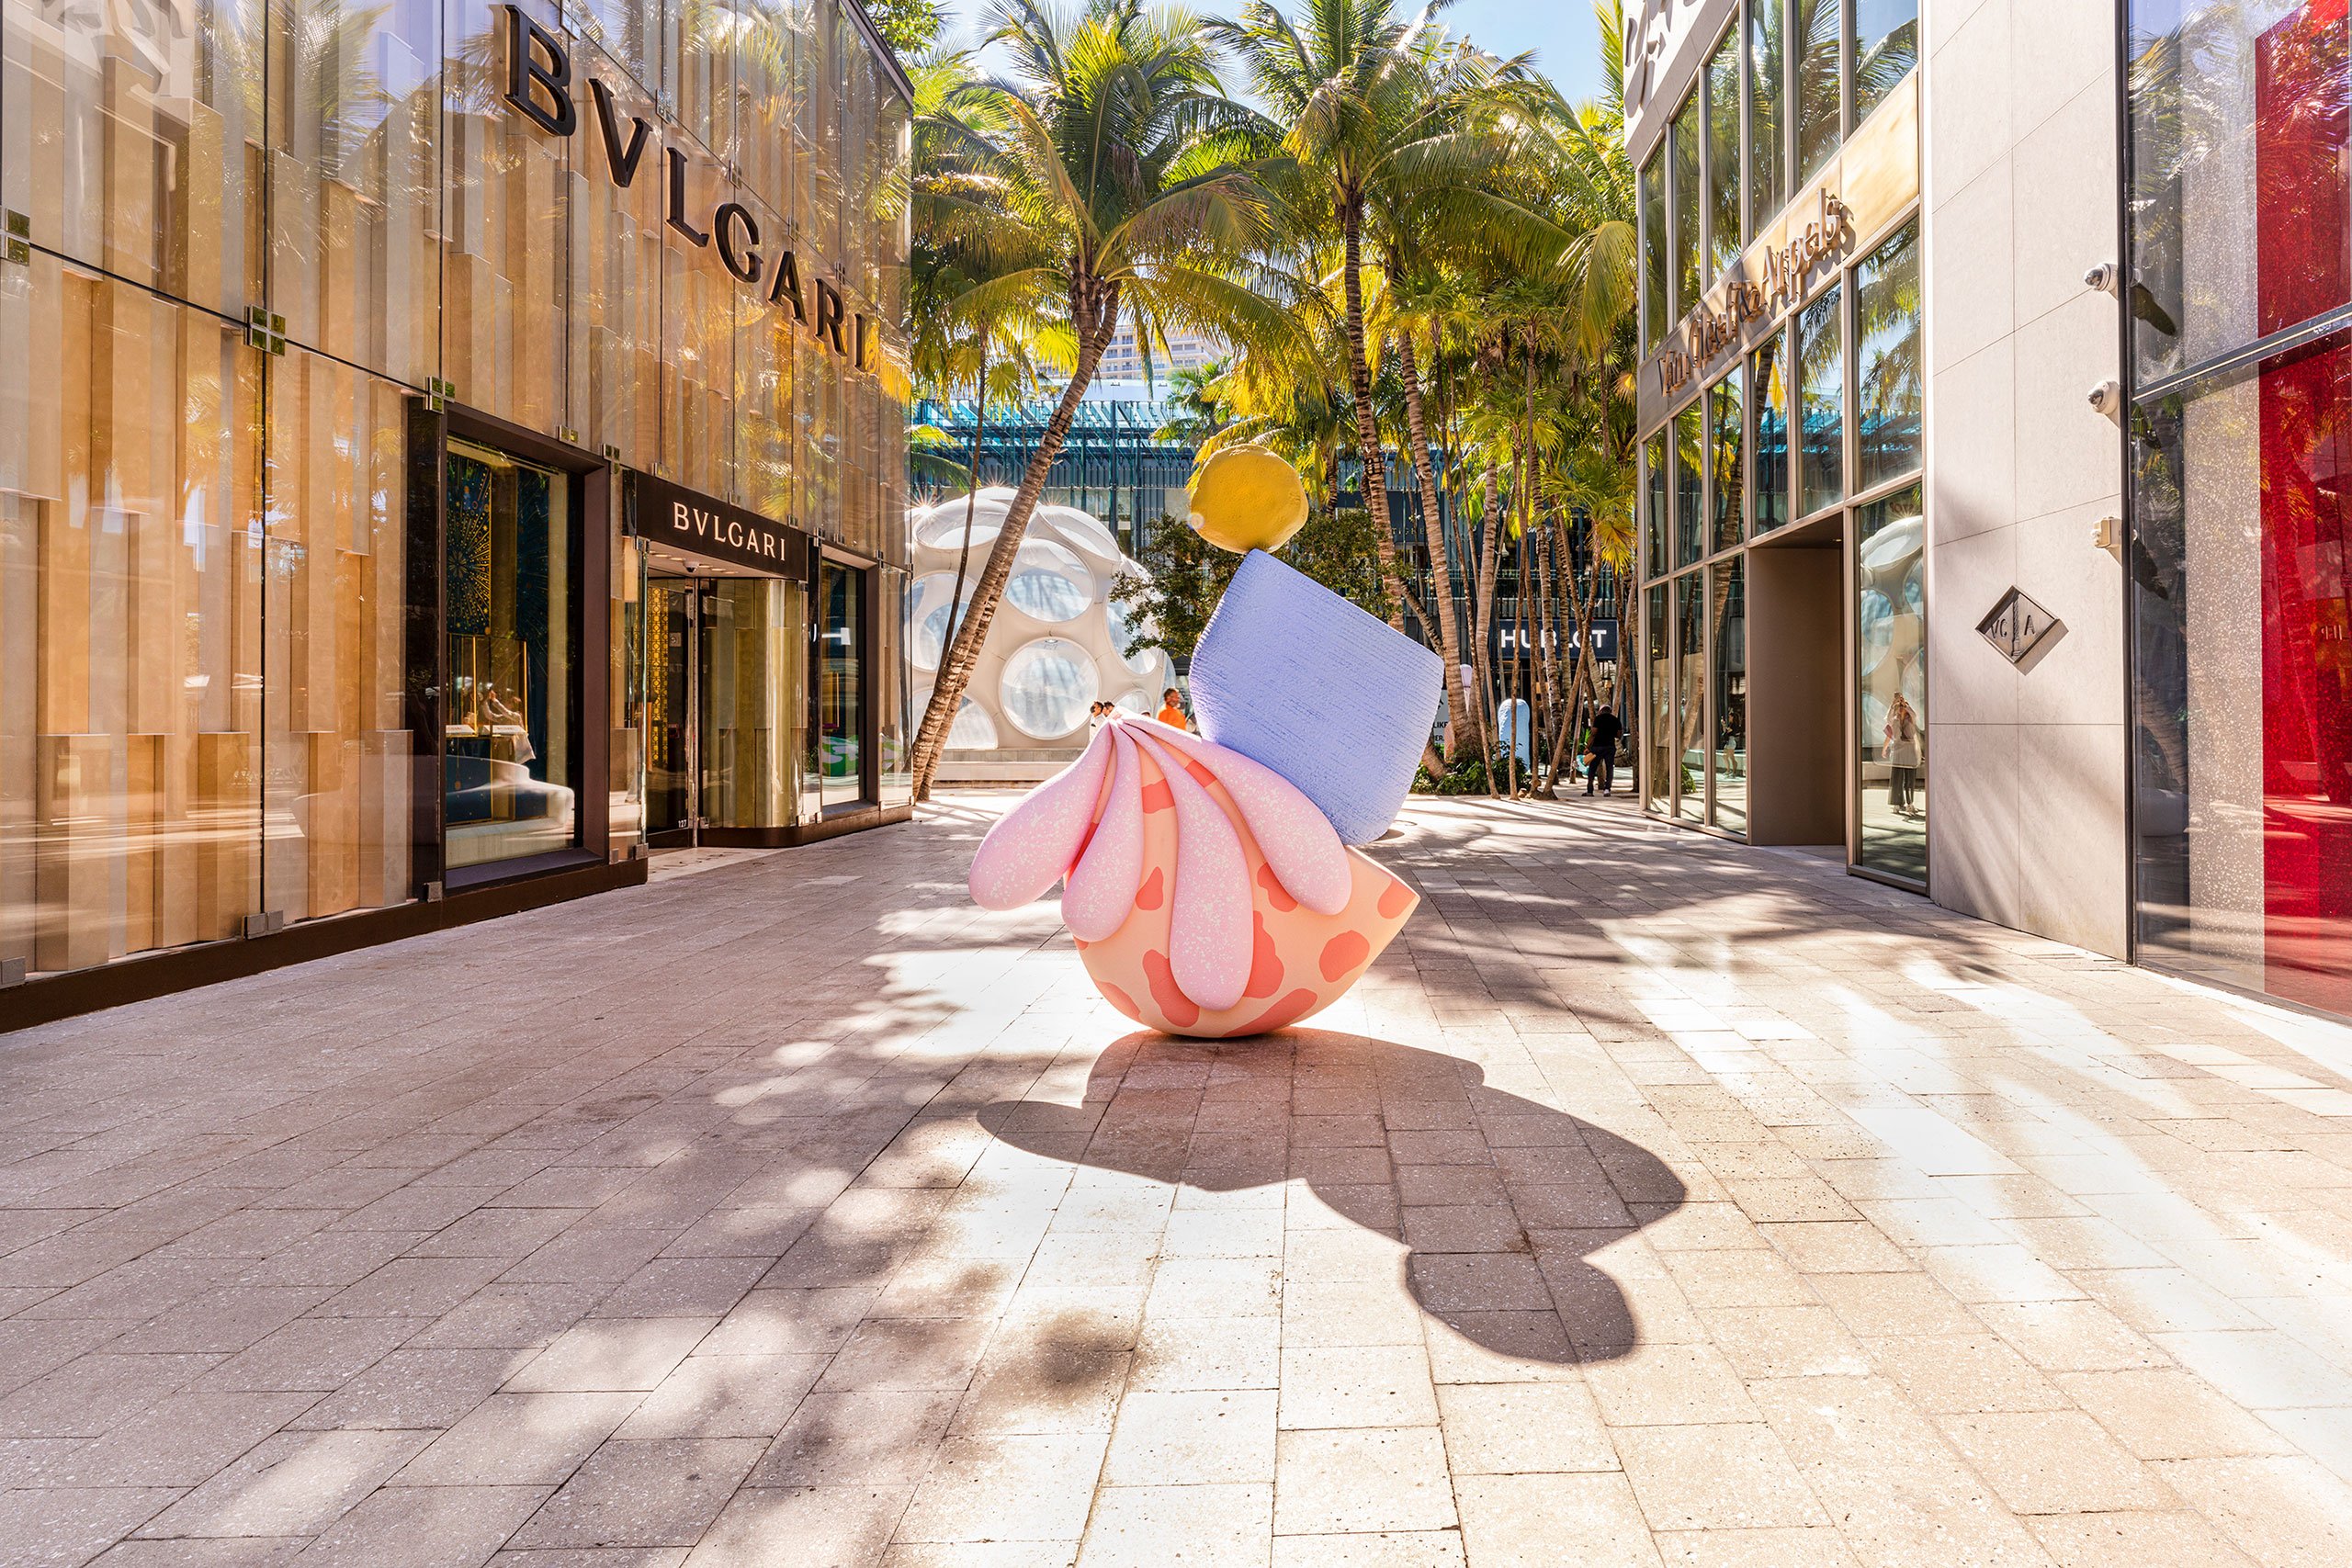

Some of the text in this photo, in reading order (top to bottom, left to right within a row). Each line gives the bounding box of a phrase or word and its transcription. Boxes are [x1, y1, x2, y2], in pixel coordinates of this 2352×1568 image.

[499, 4, 866, 369] BVLGARI
[1657, 350, 1690, 397] Van
[1758, 187, 1842, 309] Arpels
[673, 502, 786, 561] BVLGARI
